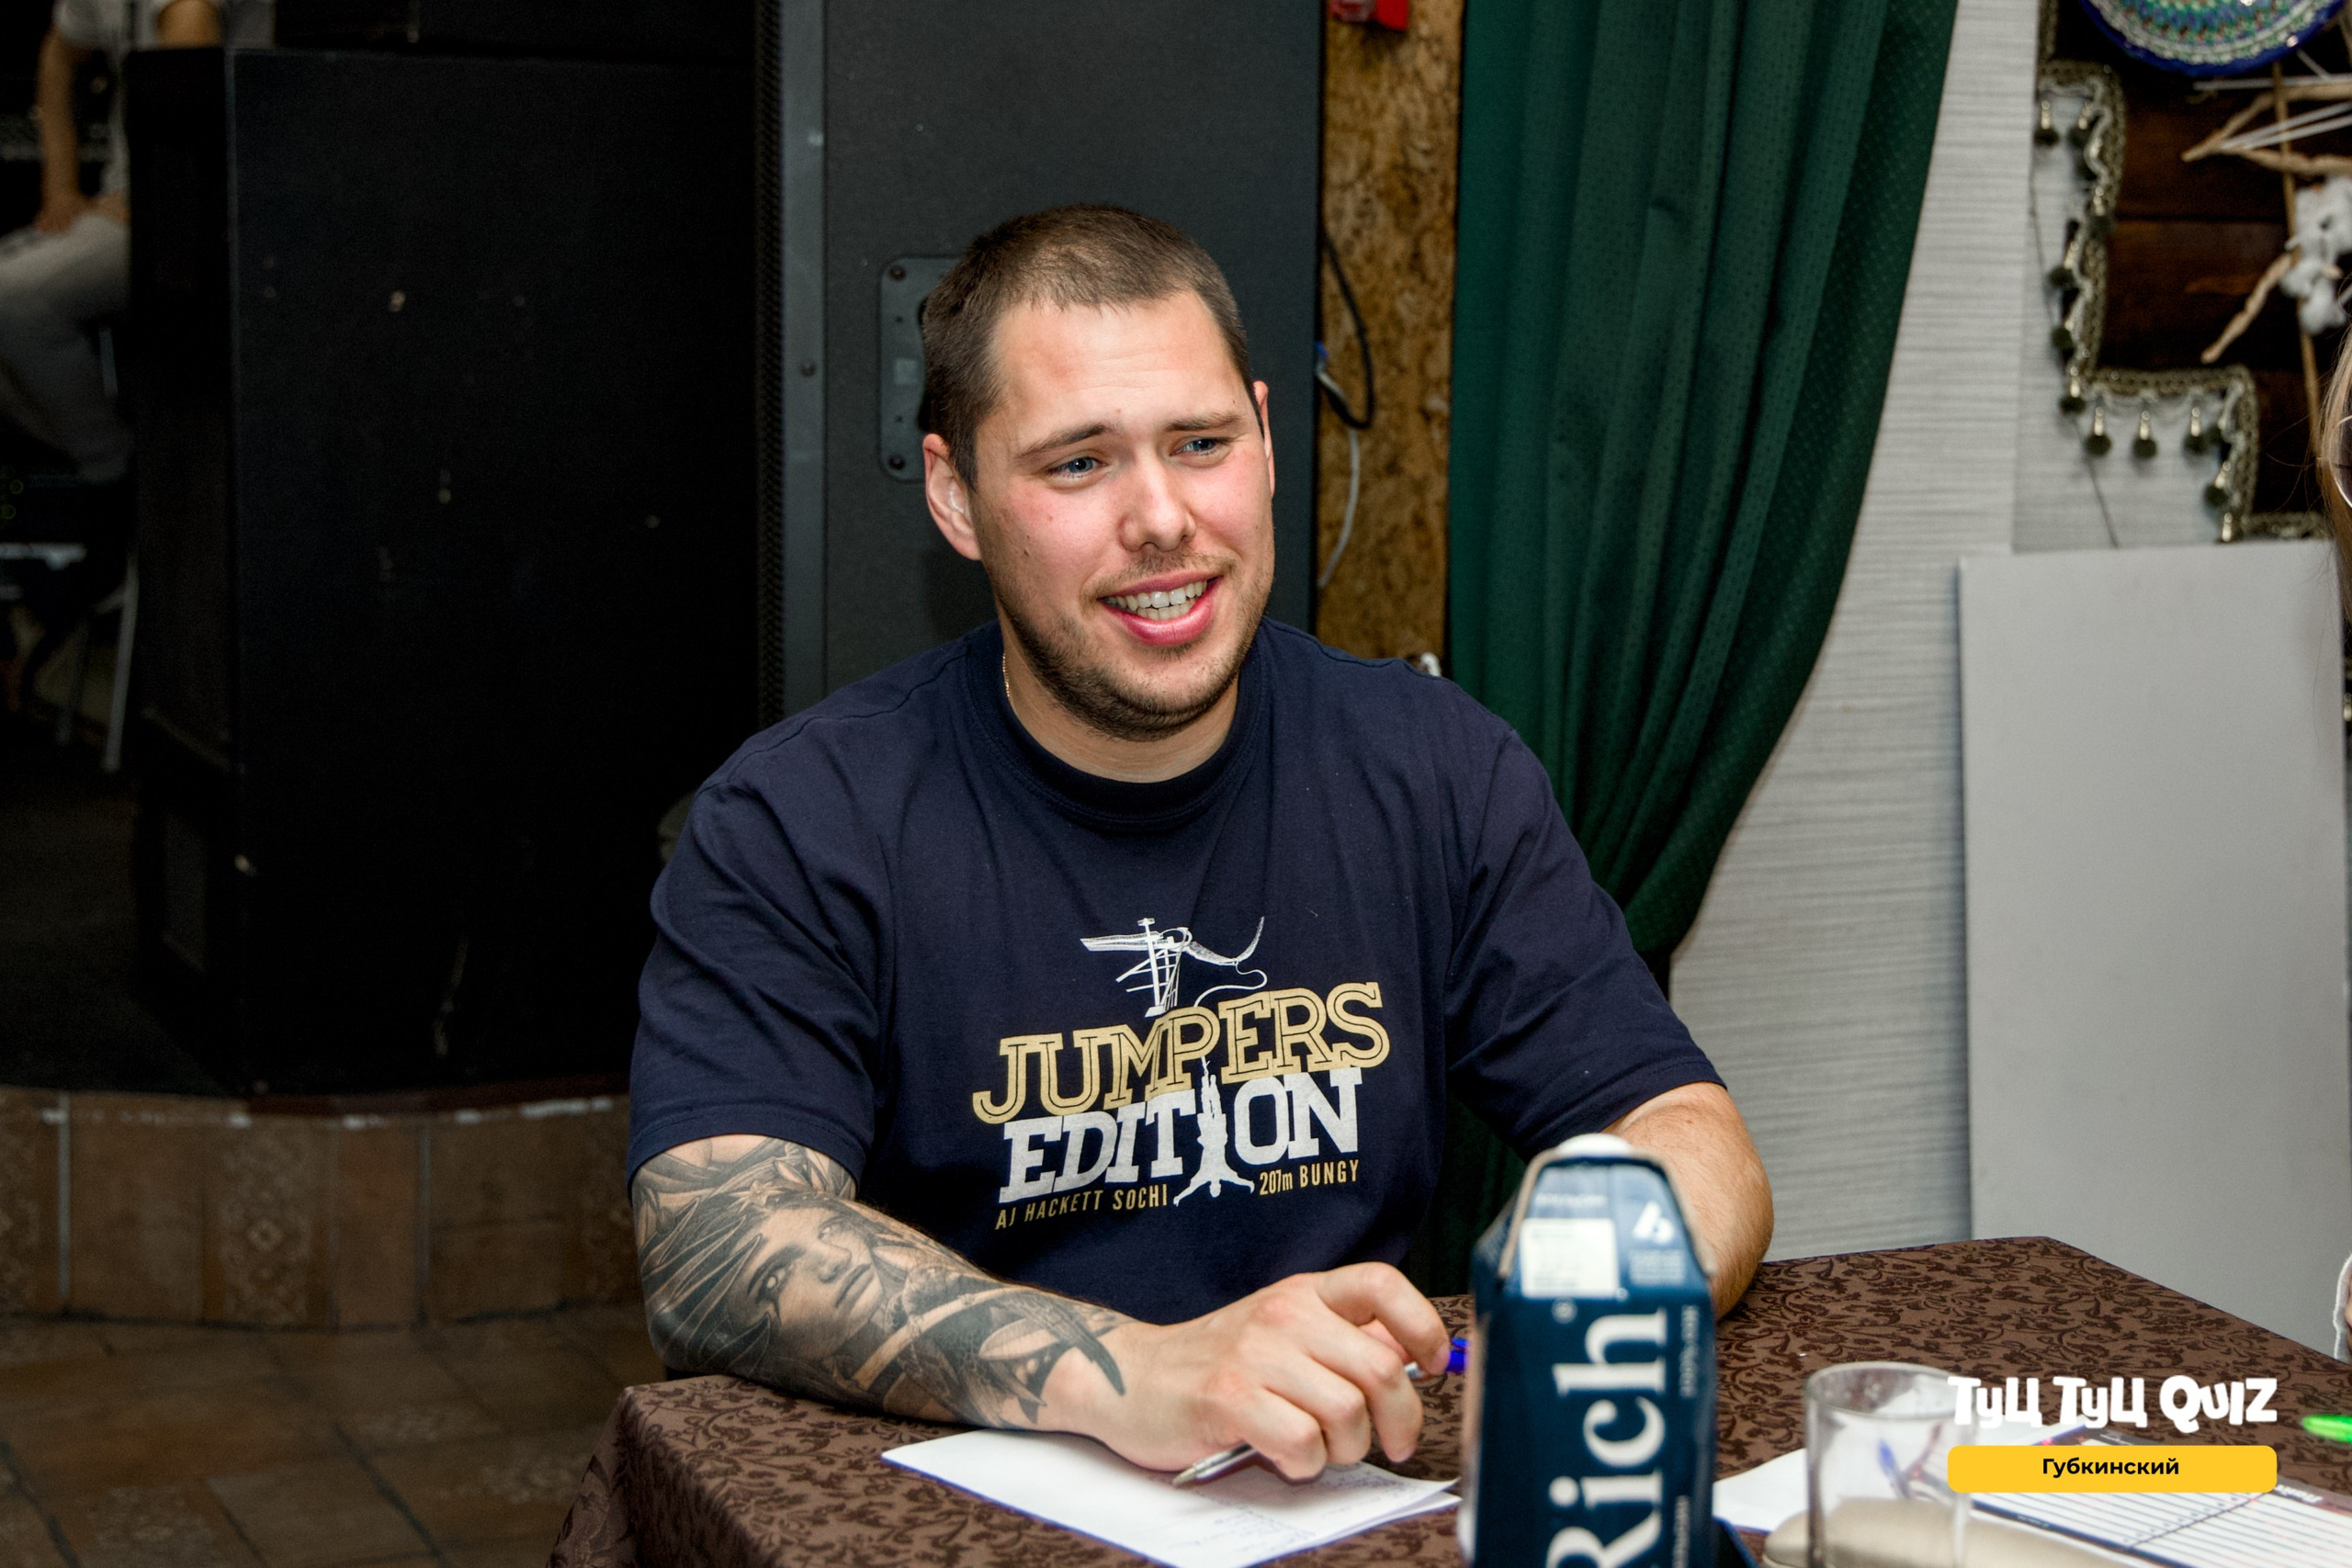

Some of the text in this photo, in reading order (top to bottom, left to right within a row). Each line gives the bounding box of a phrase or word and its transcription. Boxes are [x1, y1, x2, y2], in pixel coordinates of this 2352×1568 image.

[972, 981, 1390, 1124] JUMPERS
[995, 1183, 1168, 1230] AJ HACKETT SOCHI
[1260, 1159, 1359, 1196] 207m BUNGY
[1545, 1307, 1668, 1568] Rich
